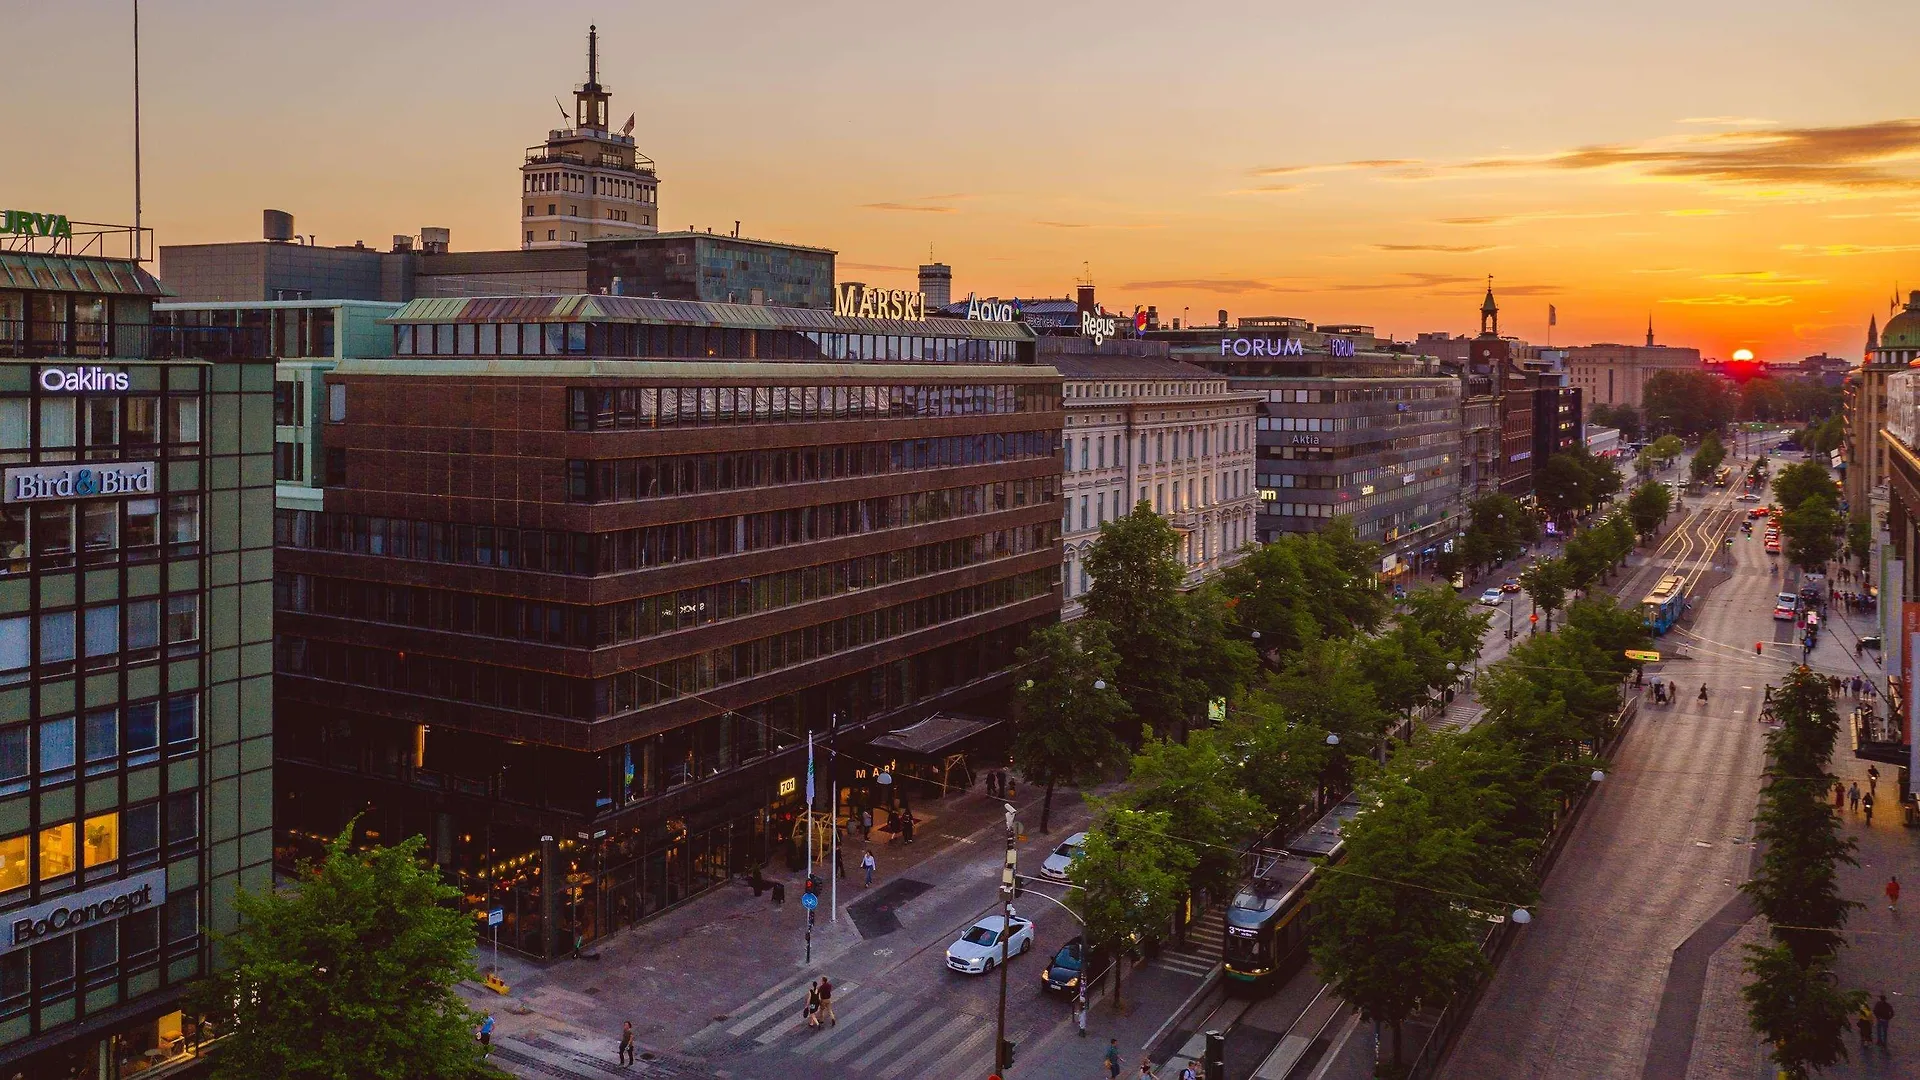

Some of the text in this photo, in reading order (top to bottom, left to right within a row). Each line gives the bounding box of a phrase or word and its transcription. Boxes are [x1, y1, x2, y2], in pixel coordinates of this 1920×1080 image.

[834, 284, 926, 322] MARSKI
[967, 292, 1012, 322] Aava
[1082, 310, 1115, 345] Regus
[1221, 338, 1303, 357] FORUM
[1331, 338, 1355, 357] FORUM
[40, 366, 129, 391] Oaklins
[1292, 434, 1320, 445] Aktia
[781, 779, 795, 793] 701
[12, 883, 152, 946] BoConcept
[1229, 926, 1235, 934] 3
